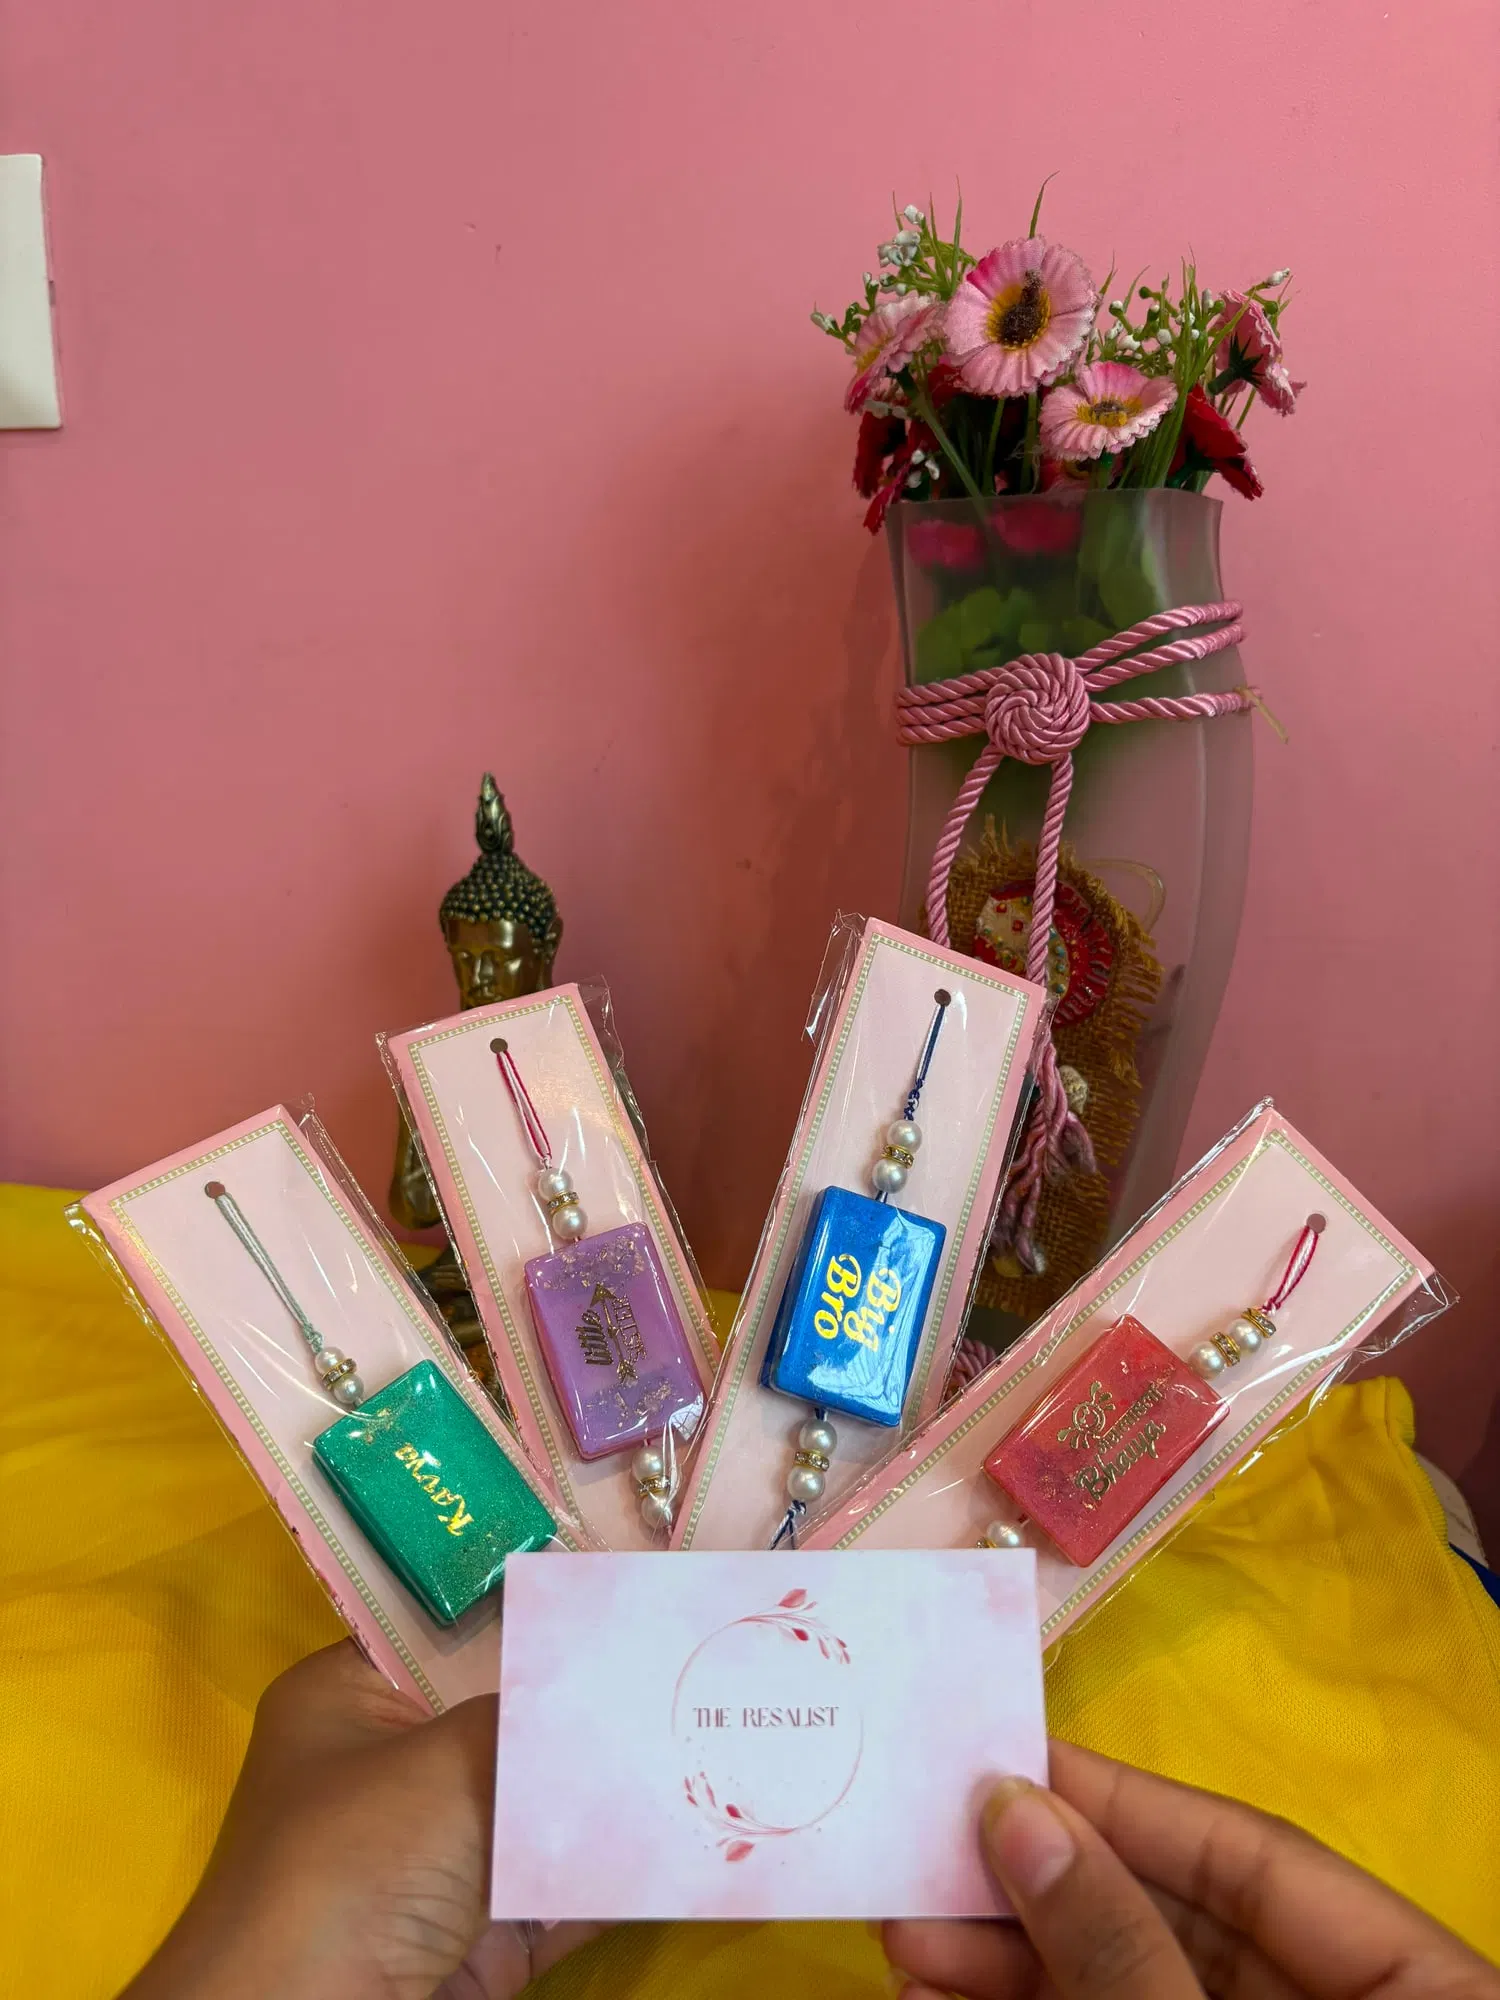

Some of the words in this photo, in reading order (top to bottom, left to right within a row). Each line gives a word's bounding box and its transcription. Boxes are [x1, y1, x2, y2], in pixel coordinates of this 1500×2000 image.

[814, 1253, 861, 1339] Bro
[843, 1267, 901, 1352] Big
[395, 1443, 474, 1536] Kavya
[1075, 1420, 1167, 1500] Bhaiya
[692, 1707, 731, 1728] THE
[742, 1706, 839, 1728] RESALIST
